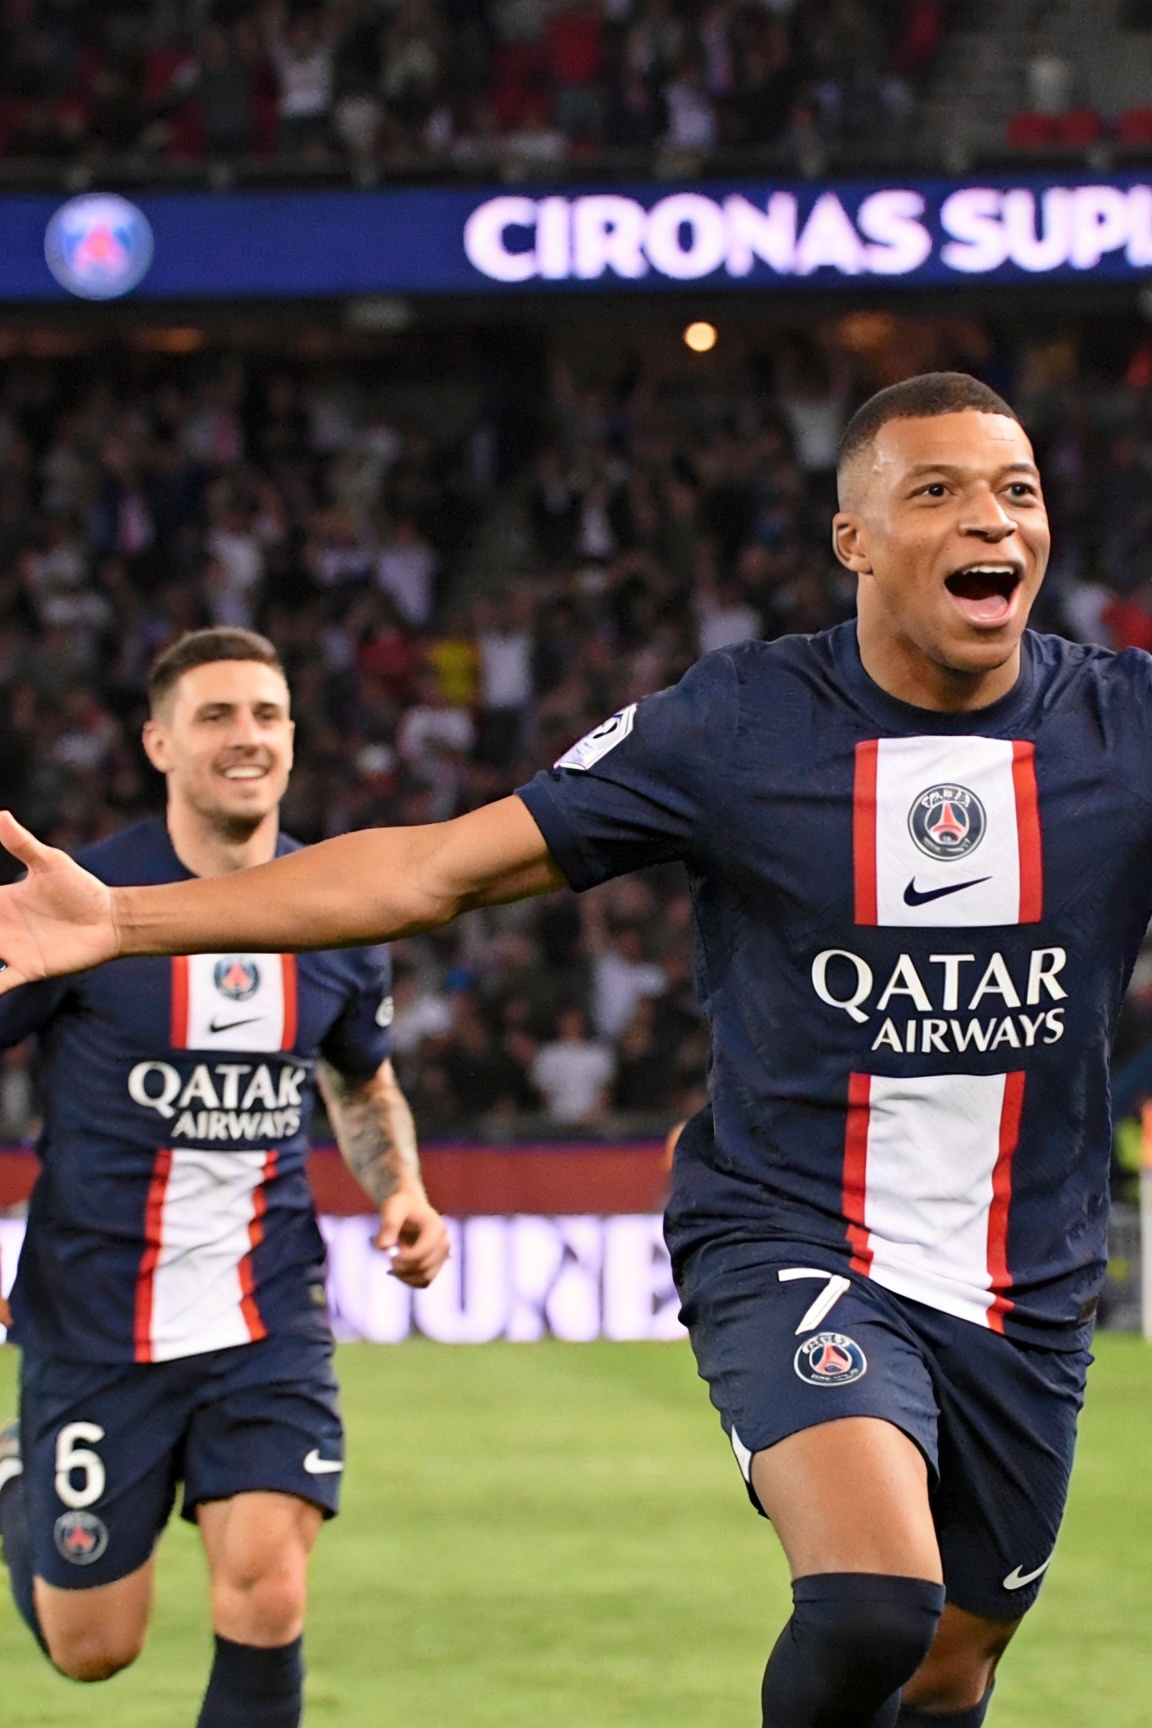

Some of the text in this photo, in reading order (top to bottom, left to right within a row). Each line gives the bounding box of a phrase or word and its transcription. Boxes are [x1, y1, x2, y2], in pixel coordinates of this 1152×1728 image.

[463, 190, 933, 283] CIRONAS
[811, 947, 1069, 1024] QATAR
[871, 1007, 1065, 1053] AIRWAYS
[127, 1061, 307, 1119] QATAR
[170, 1108, 301, 1141] AIRWAYS
[778, 1267, 851, 1335] 7
[55, 1421, 106, 1508] 6
